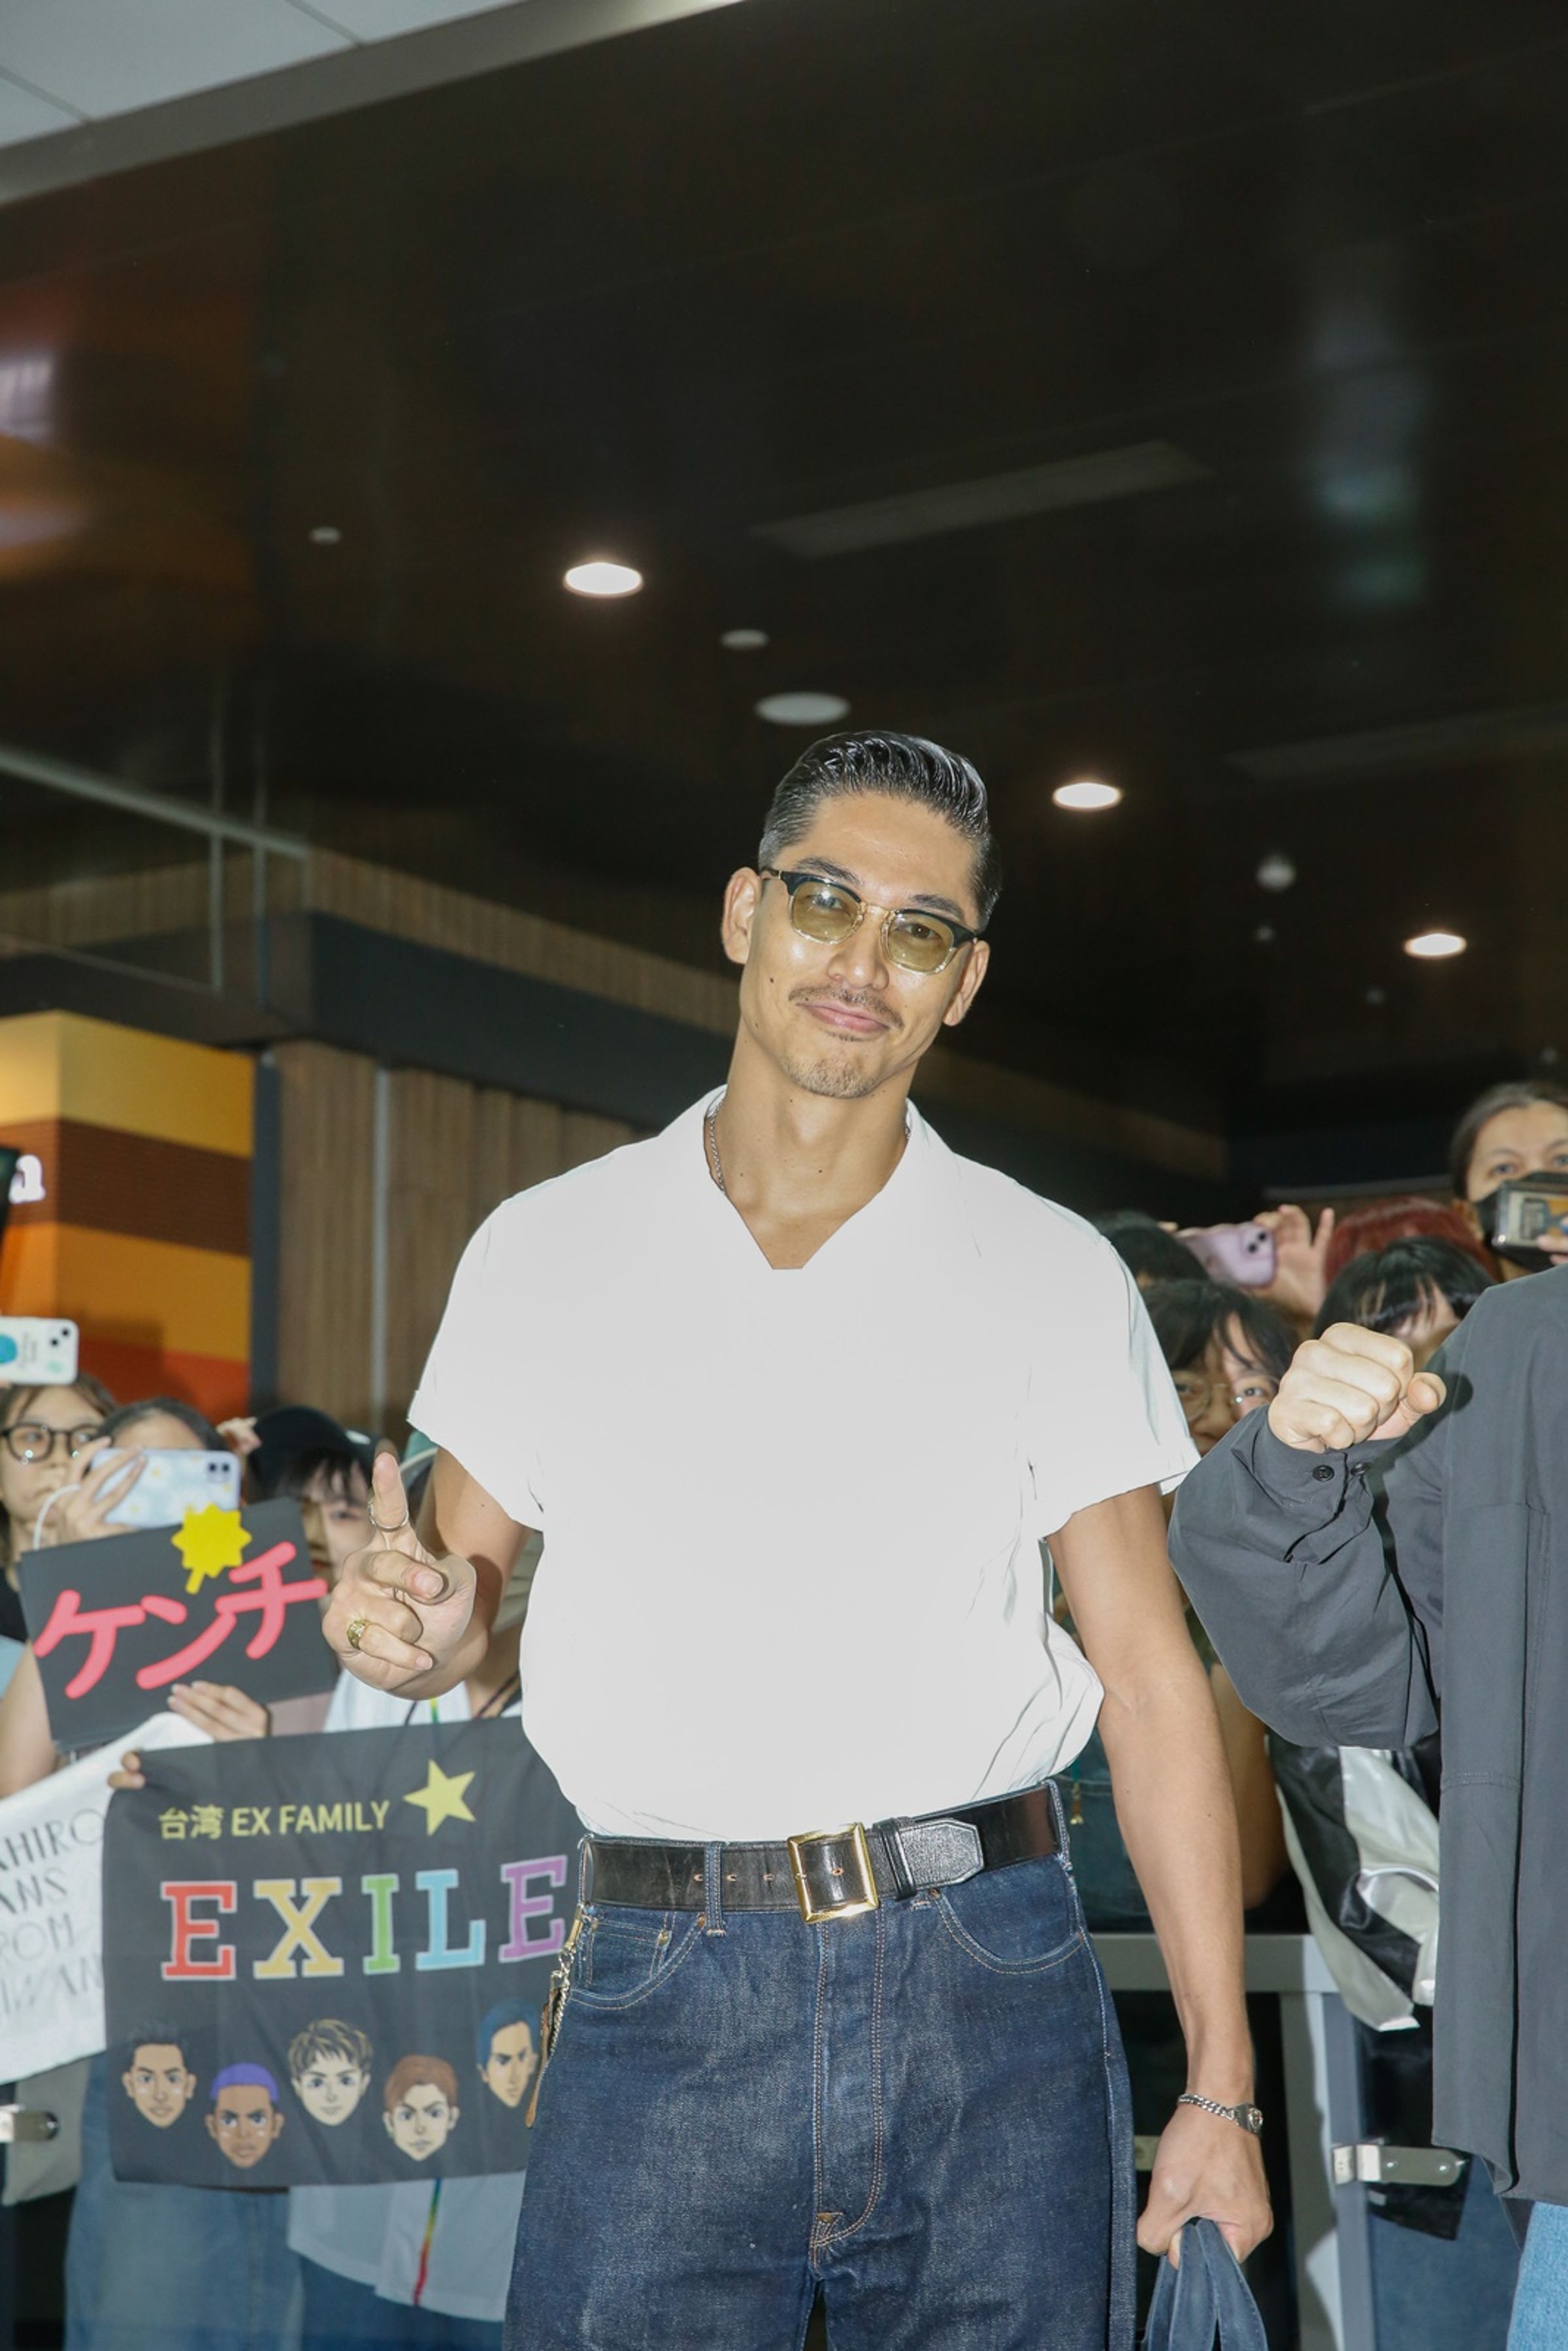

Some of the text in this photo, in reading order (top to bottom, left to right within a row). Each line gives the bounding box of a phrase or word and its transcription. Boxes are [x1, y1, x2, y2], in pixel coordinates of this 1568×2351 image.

[33, 1540, 328, 1700] ケンチ
[159, 1800, 390, 1840] 台湾 EX FAMILY
[161, 1854, 568, 1981] EXILE
